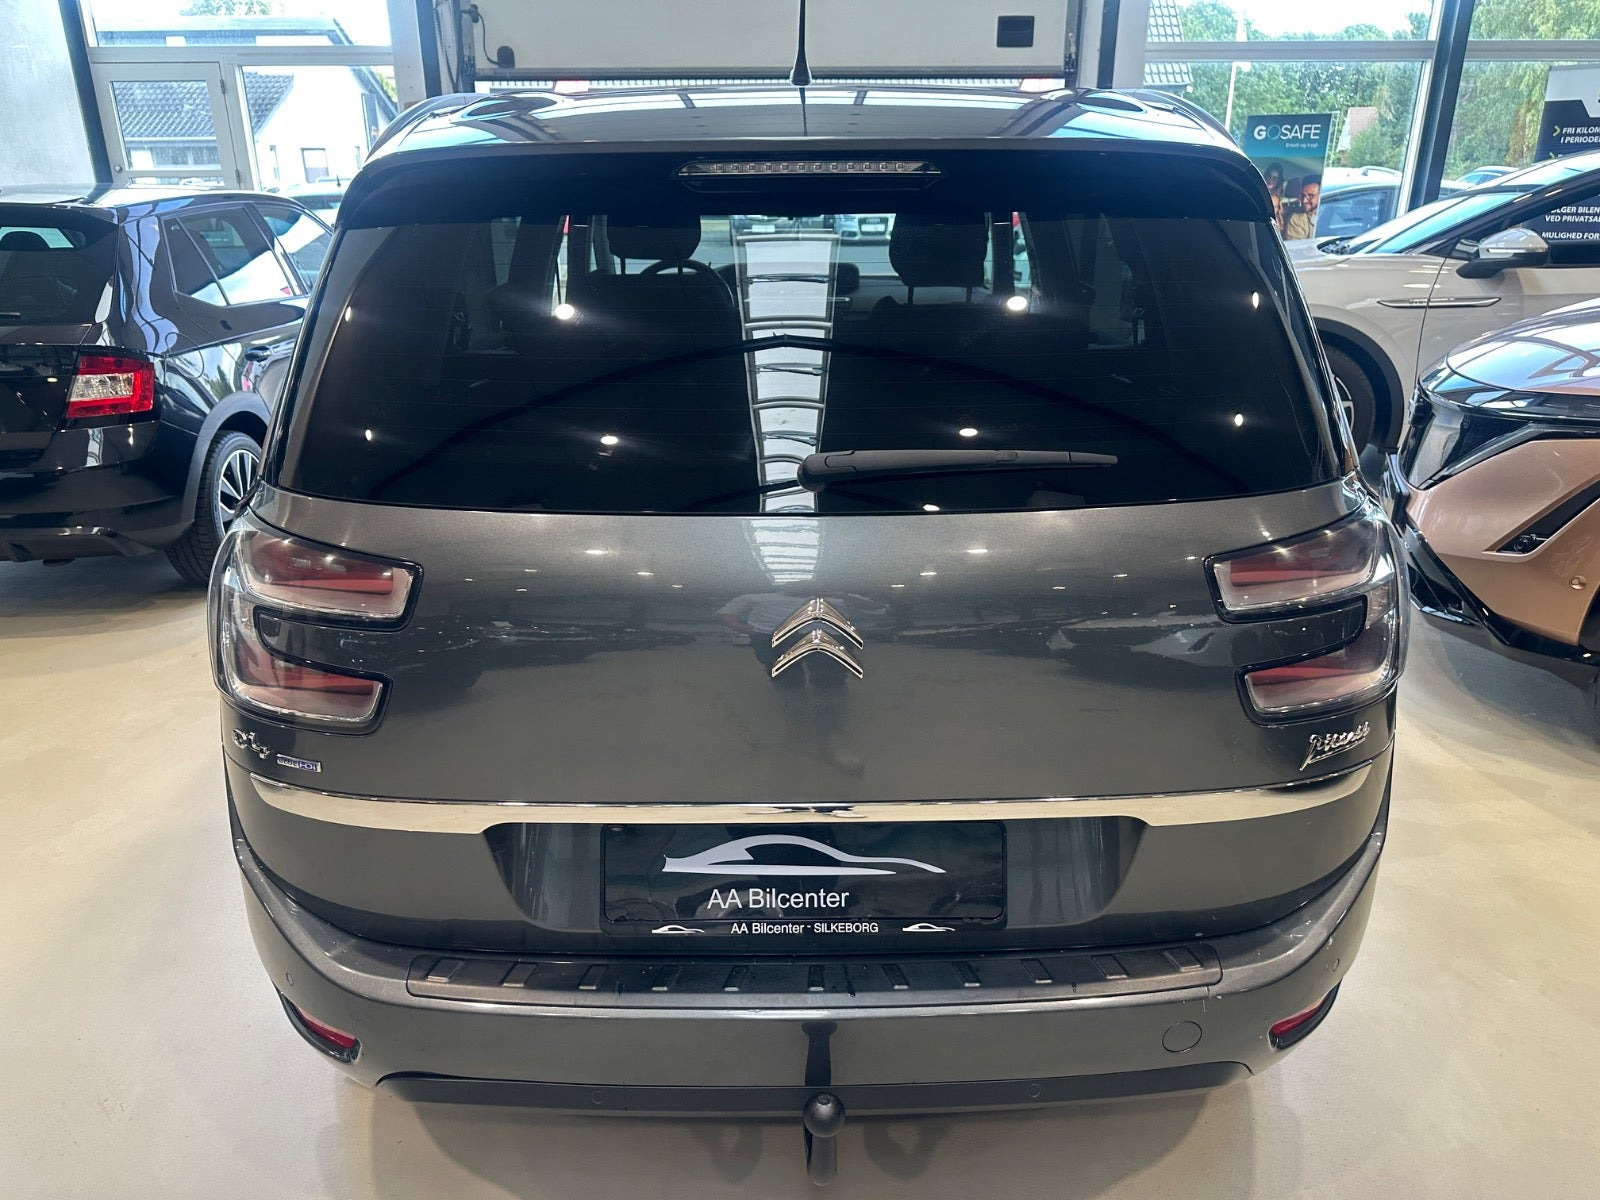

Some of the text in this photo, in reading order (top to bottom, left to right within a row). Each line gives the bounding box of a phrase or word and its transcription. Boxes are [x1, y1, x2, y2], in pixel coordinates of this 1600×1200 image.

[1253, 124, 1321, 140] GOSAFE
[1584, 232, 1600, 240] FOR
[707, 887, 849, 909] AA Bilcenter
[731, 923, 748, 934] AA
[751, 923, 804, 934] Bilcenter
[813, 922, 879, 933] SILKEBORG
